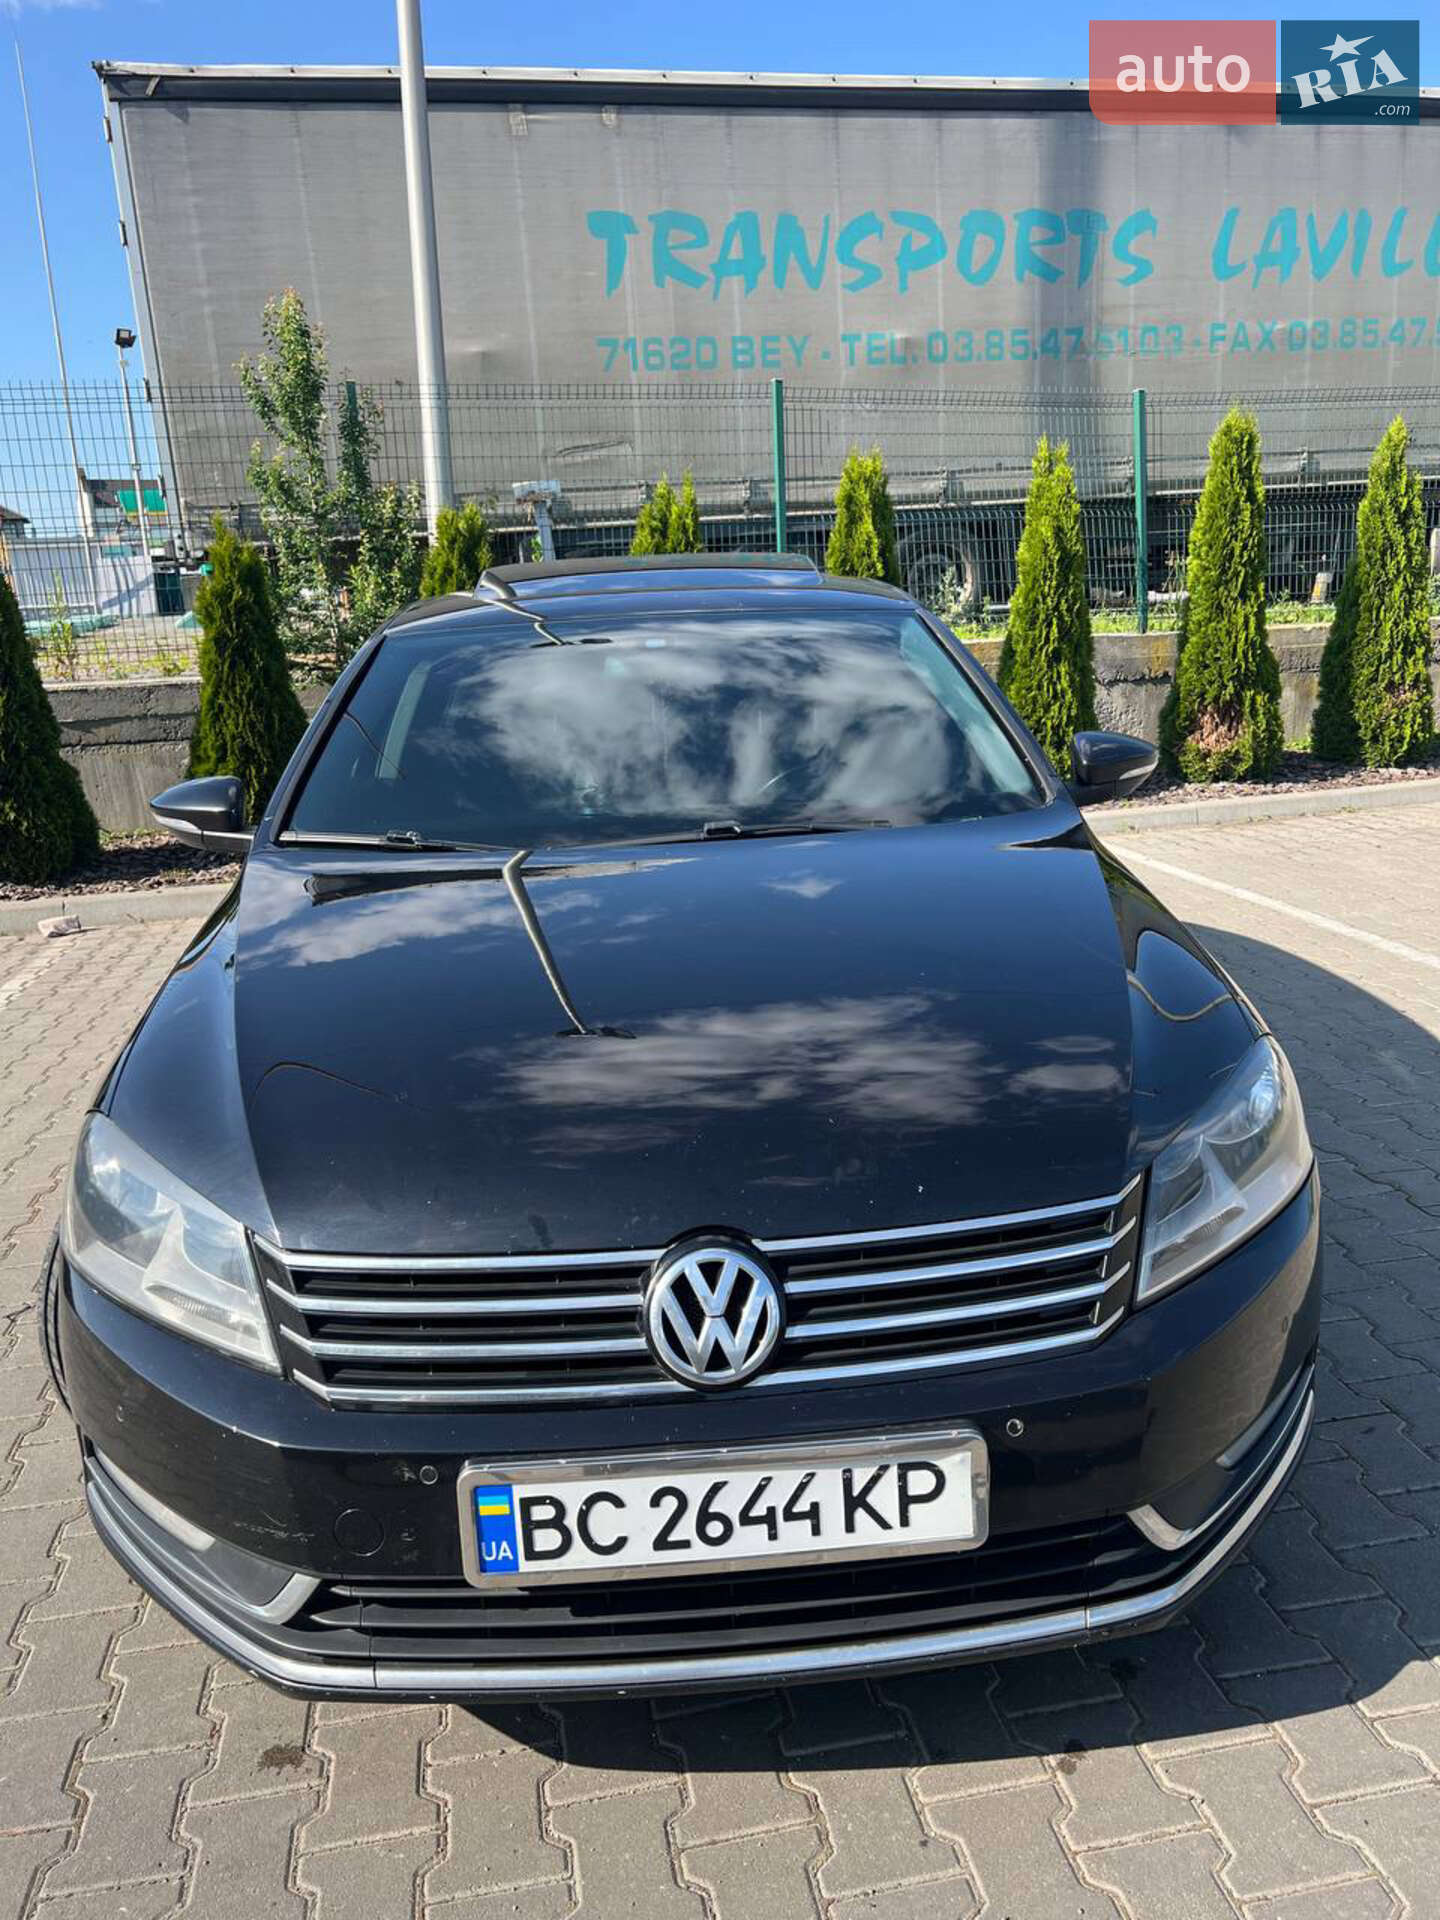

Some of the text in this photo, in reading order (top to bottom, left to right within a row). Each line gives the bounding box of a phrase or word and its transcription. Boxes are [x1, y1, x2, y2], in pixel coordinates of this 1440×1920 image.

[586, 207, 1158, 302] TRANSPORTS
[596, 335, 718, 372] 71620
[731, 334, 810, 369] BEY
[518, 1460, 947, 1562] BC 2644 KP
[480, 1540, 514, 1562] UA
